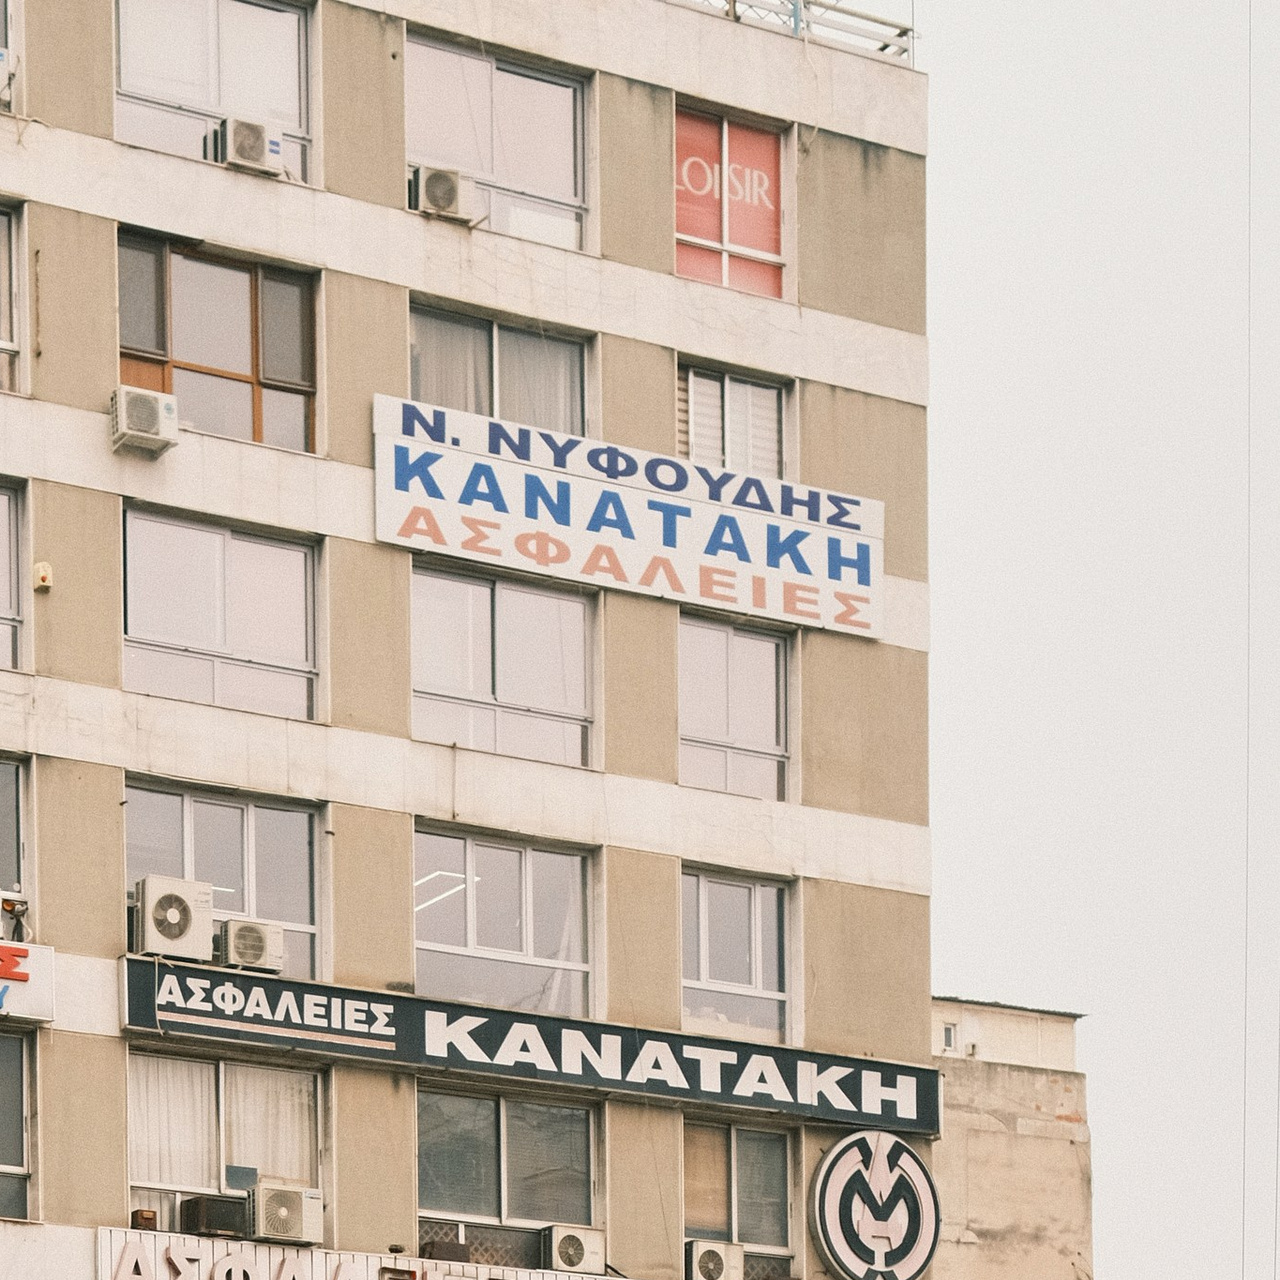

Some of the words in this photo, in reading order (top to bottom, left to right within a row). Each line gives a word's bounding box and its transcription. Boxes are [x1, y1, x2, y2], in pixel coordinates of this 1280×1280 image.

[676, 156, 775, 210] OISIR
[393, 445, 871, 587] ΚΑΝΑΤΑΚΗ
[401, 403, 461, 447] Ν.
[487, 423, 862, 531] ΝΥΦΟΥΔΗΣ
[396, 506, 872, 630] ΑΣΦΑΛΕΙΕΣ
[157, 973, 397, 1036] ΑΣΦΑΛΕΙΕΣ
[424, 1010, 918, 1120] ΚΑΝΑΤΑΚΗ
